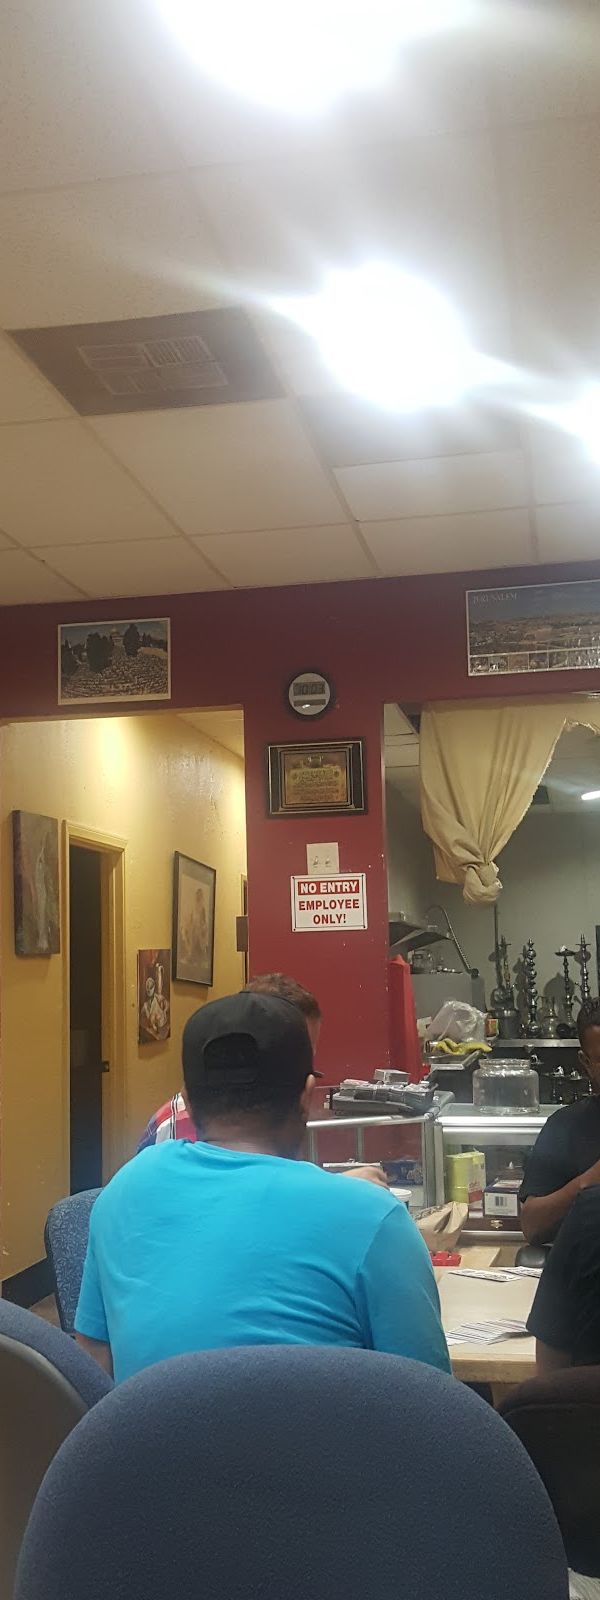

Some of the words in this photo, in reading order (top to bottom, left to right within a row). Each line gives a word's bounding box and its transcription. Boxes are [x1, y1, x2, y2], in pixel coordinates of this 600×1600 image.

[473, 591, 518, 604] JERUSALEM
[300, 882, 317, 894] NO
[319, 881, 358, 893] ENTRY
[298, 899, 360, 911] EMPLOYEE
[313, 913, 347, 925] ONLY!
